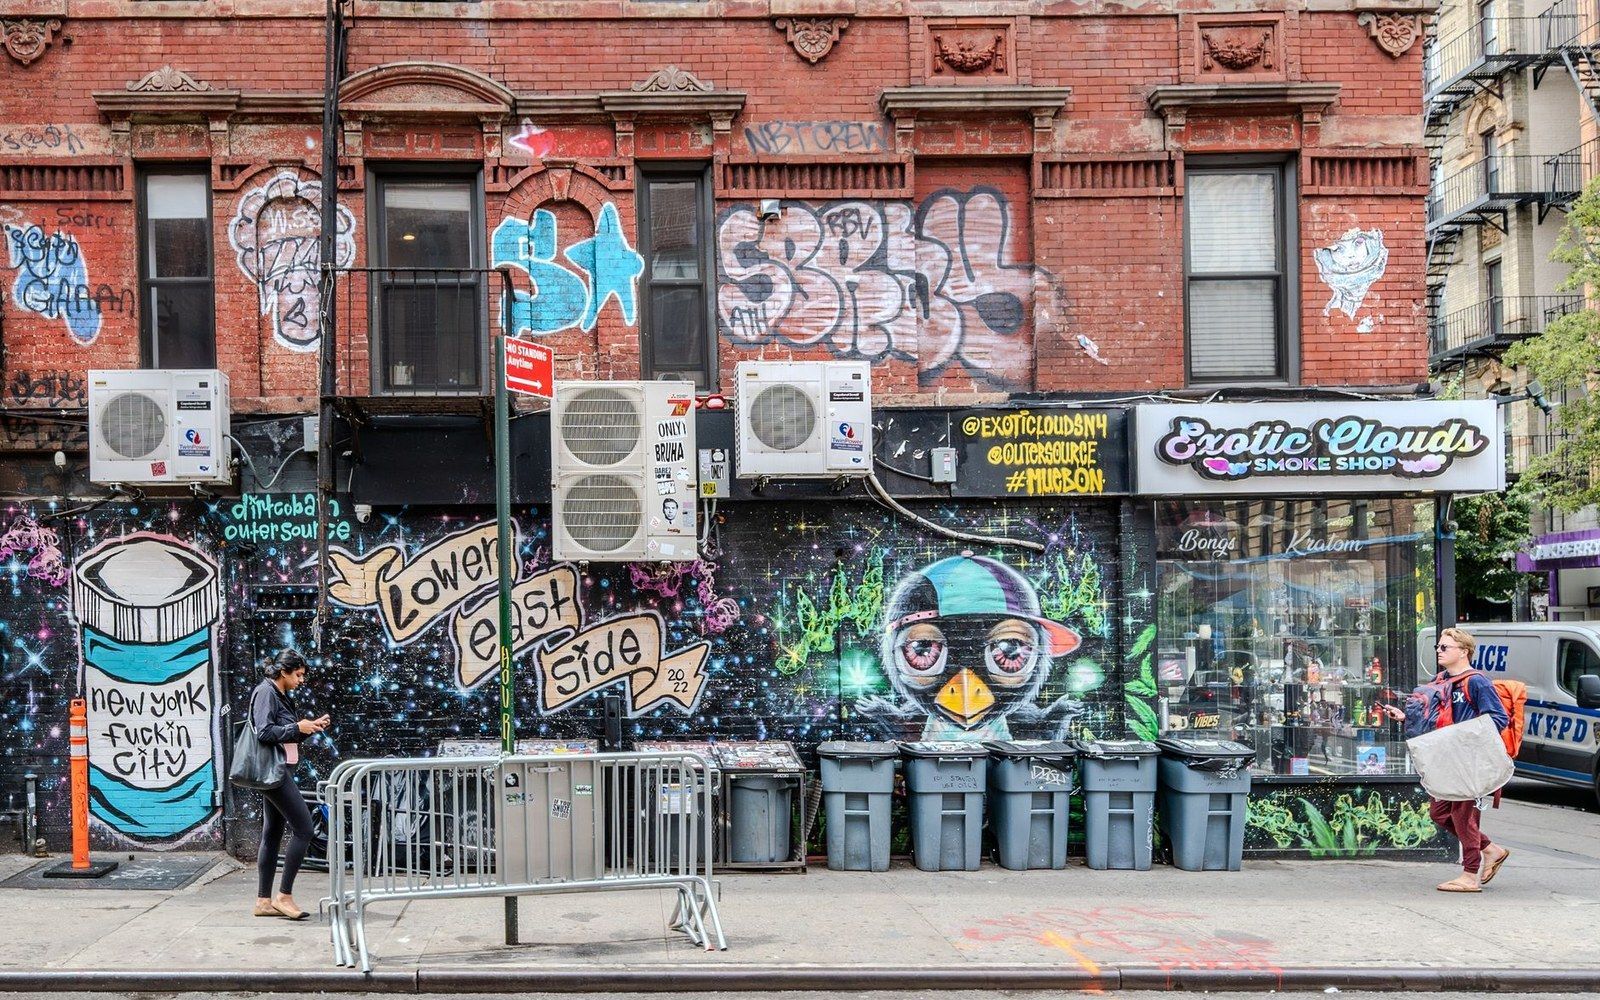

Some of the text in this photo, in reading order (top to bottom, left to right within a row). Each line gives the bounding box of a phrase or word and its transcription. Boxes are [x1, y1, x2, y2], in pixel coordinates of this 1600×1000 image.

[507, 342, 547, 362] NO STANDING
[508, 355, 534, 370] Anytime
[1165, 420, 1484, 459] Exotic Clouds
[655, 443, 685, 462] BRUHA
[1254, 457, 1396, 471] SMOKE SHOP
[1179, 529, 1363, 558] Bongs Kratom
[668, 668, 685, 681] 20
[674, 682, 688, 693] 22
[91, 681, 207, 718] new york
[1194, 714, 1220, 728] VIBES
[1528, 712, 1588, 743] NYPD
